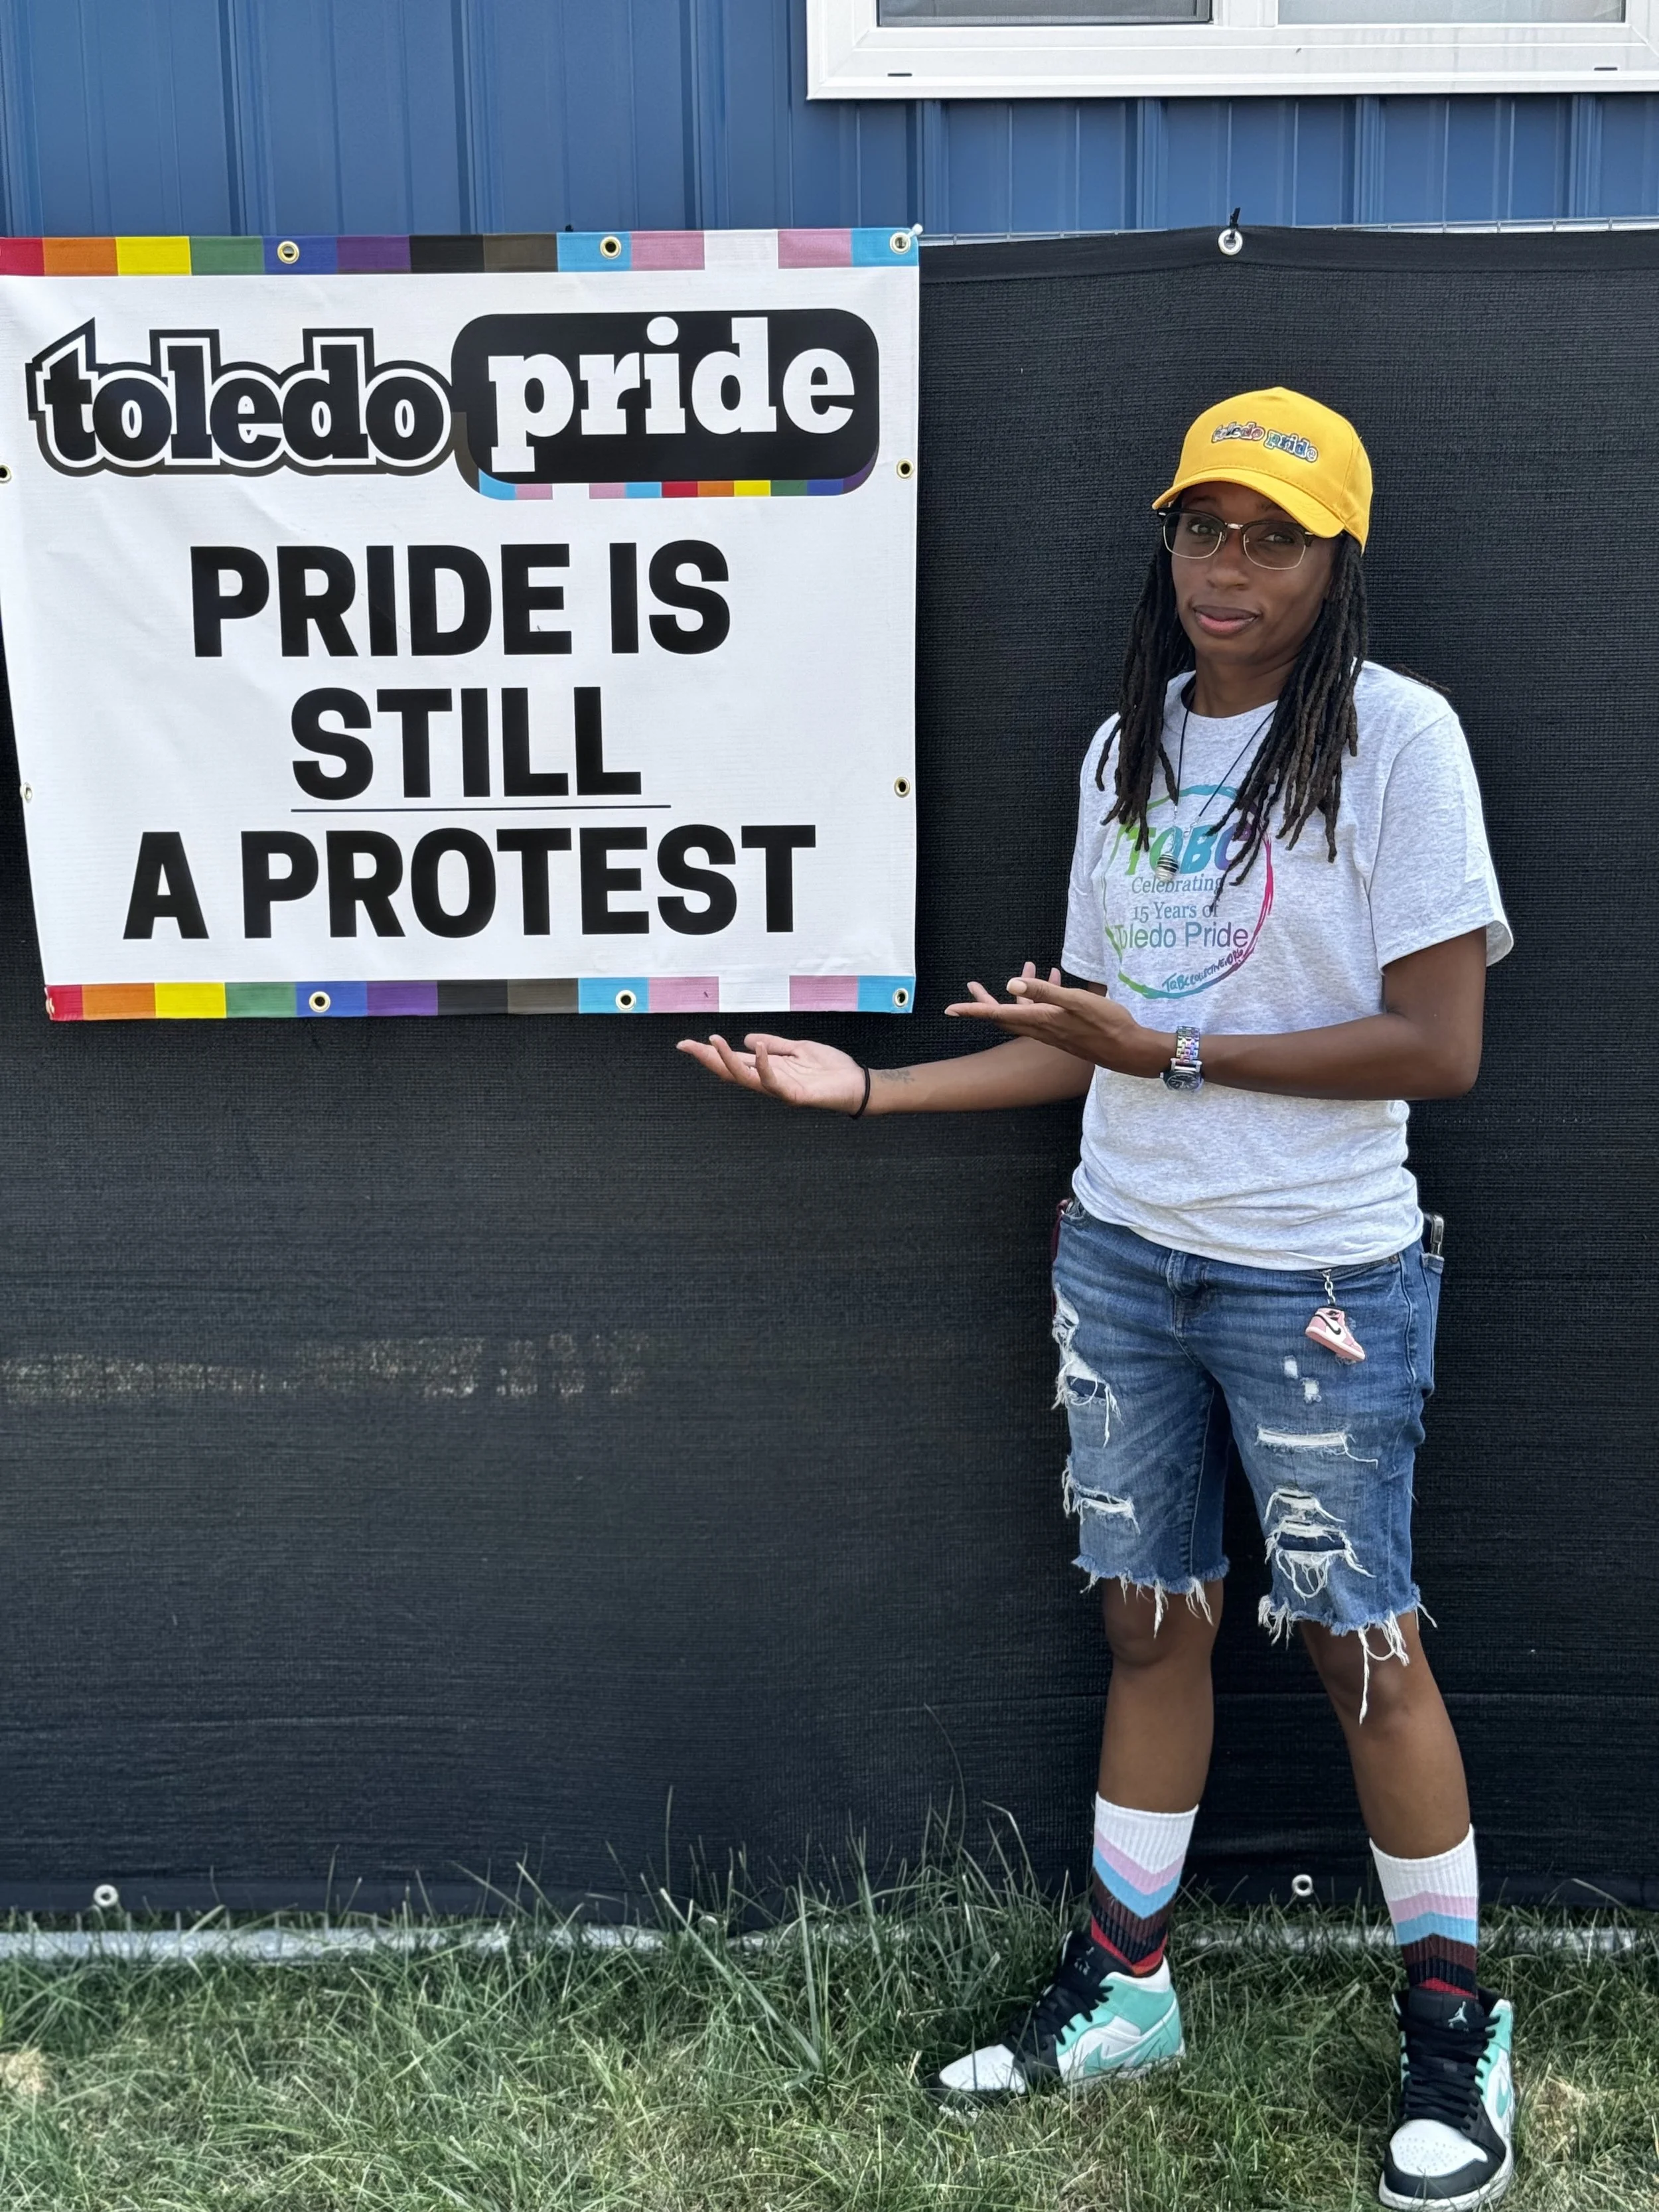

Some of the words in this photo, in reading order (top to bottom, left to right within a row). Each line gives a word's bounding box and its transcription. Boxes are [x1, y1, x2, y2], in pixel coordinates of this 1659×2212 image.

[32, 328, 450, 470] toledo
[487, 316, 855, 473] pride
[1212, 421, 1265, 443] toledo
[1263, 429, 1319, 463] pride
[190, 544, 572, 657] PRIDE
[609, 540, 730, 655] IS
[291, 686, 641, 800] STILL
[123, 832, 209, 940] A
[241, 824, 816, 938] PROTEST
[1131, 873, 1224, 894] Celebrating
[1133, 906, 1149, 924] 15
[1153, 901, 1197, 919] Years
[1202, 900, 1219, 919] of
[1114, 922, 1177, 950] Toledo
[1185, 921, 1249, 948] Pride
